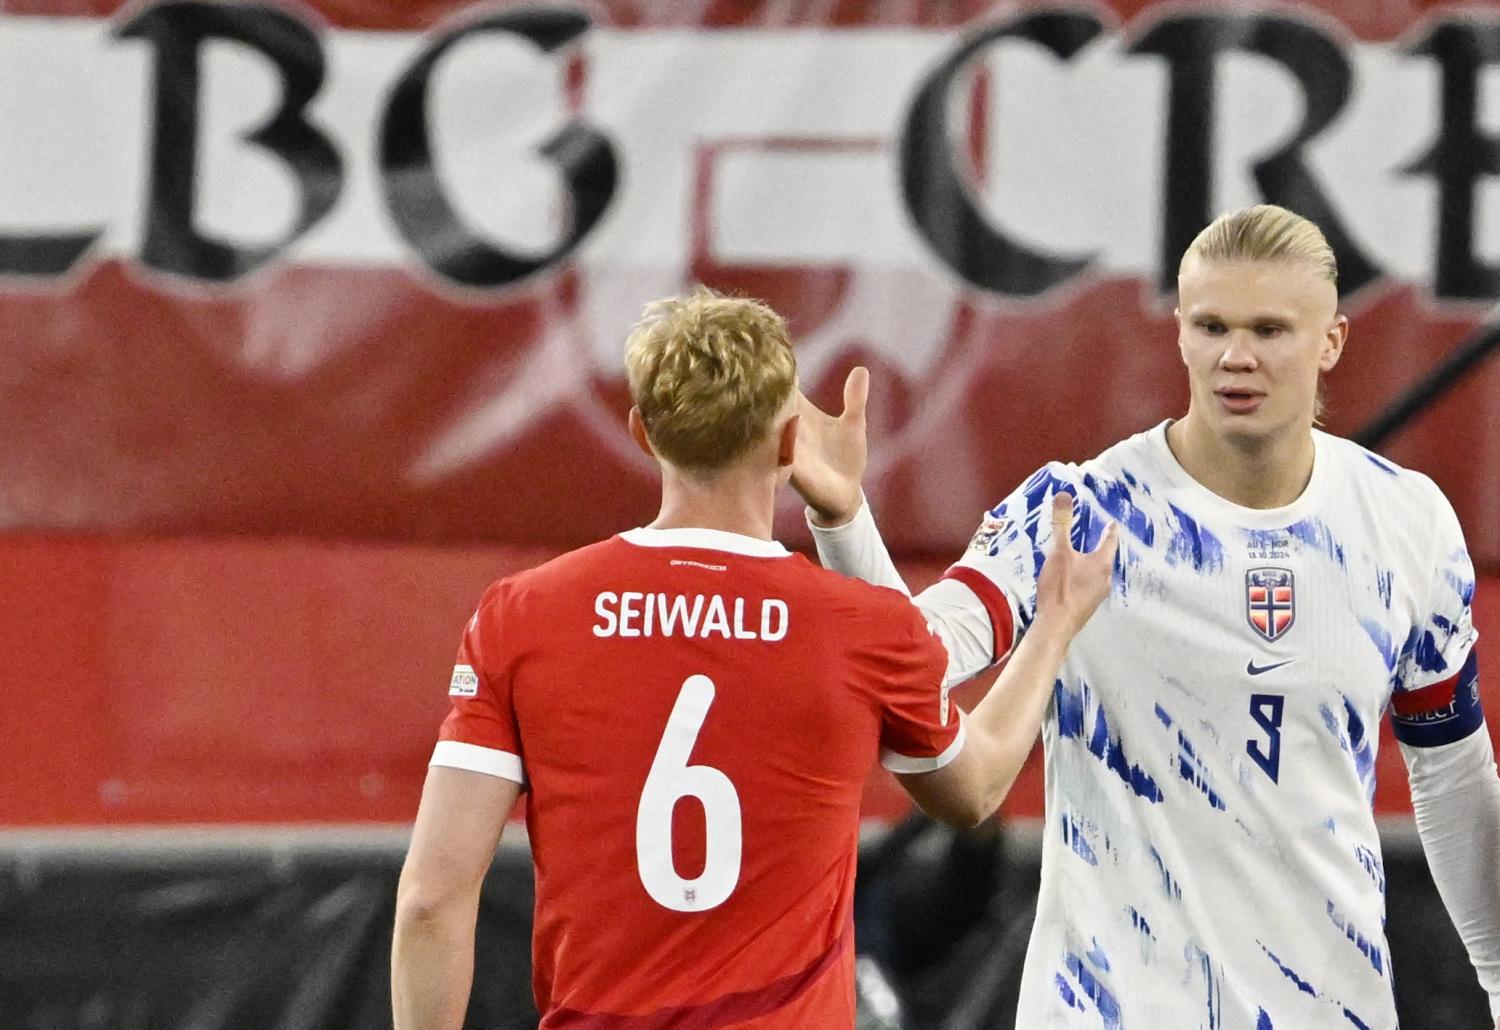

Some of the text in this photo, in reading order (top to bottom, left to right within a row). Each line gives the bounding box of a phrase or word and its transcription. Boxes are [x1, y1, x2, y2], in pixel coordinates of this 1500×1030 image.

[0, 1, 621, 288] BG
[592, 591, 789, 642] SEIWALD
[636, 674, 742, 912] 6
[1246, 693, 1285, 785] 9
